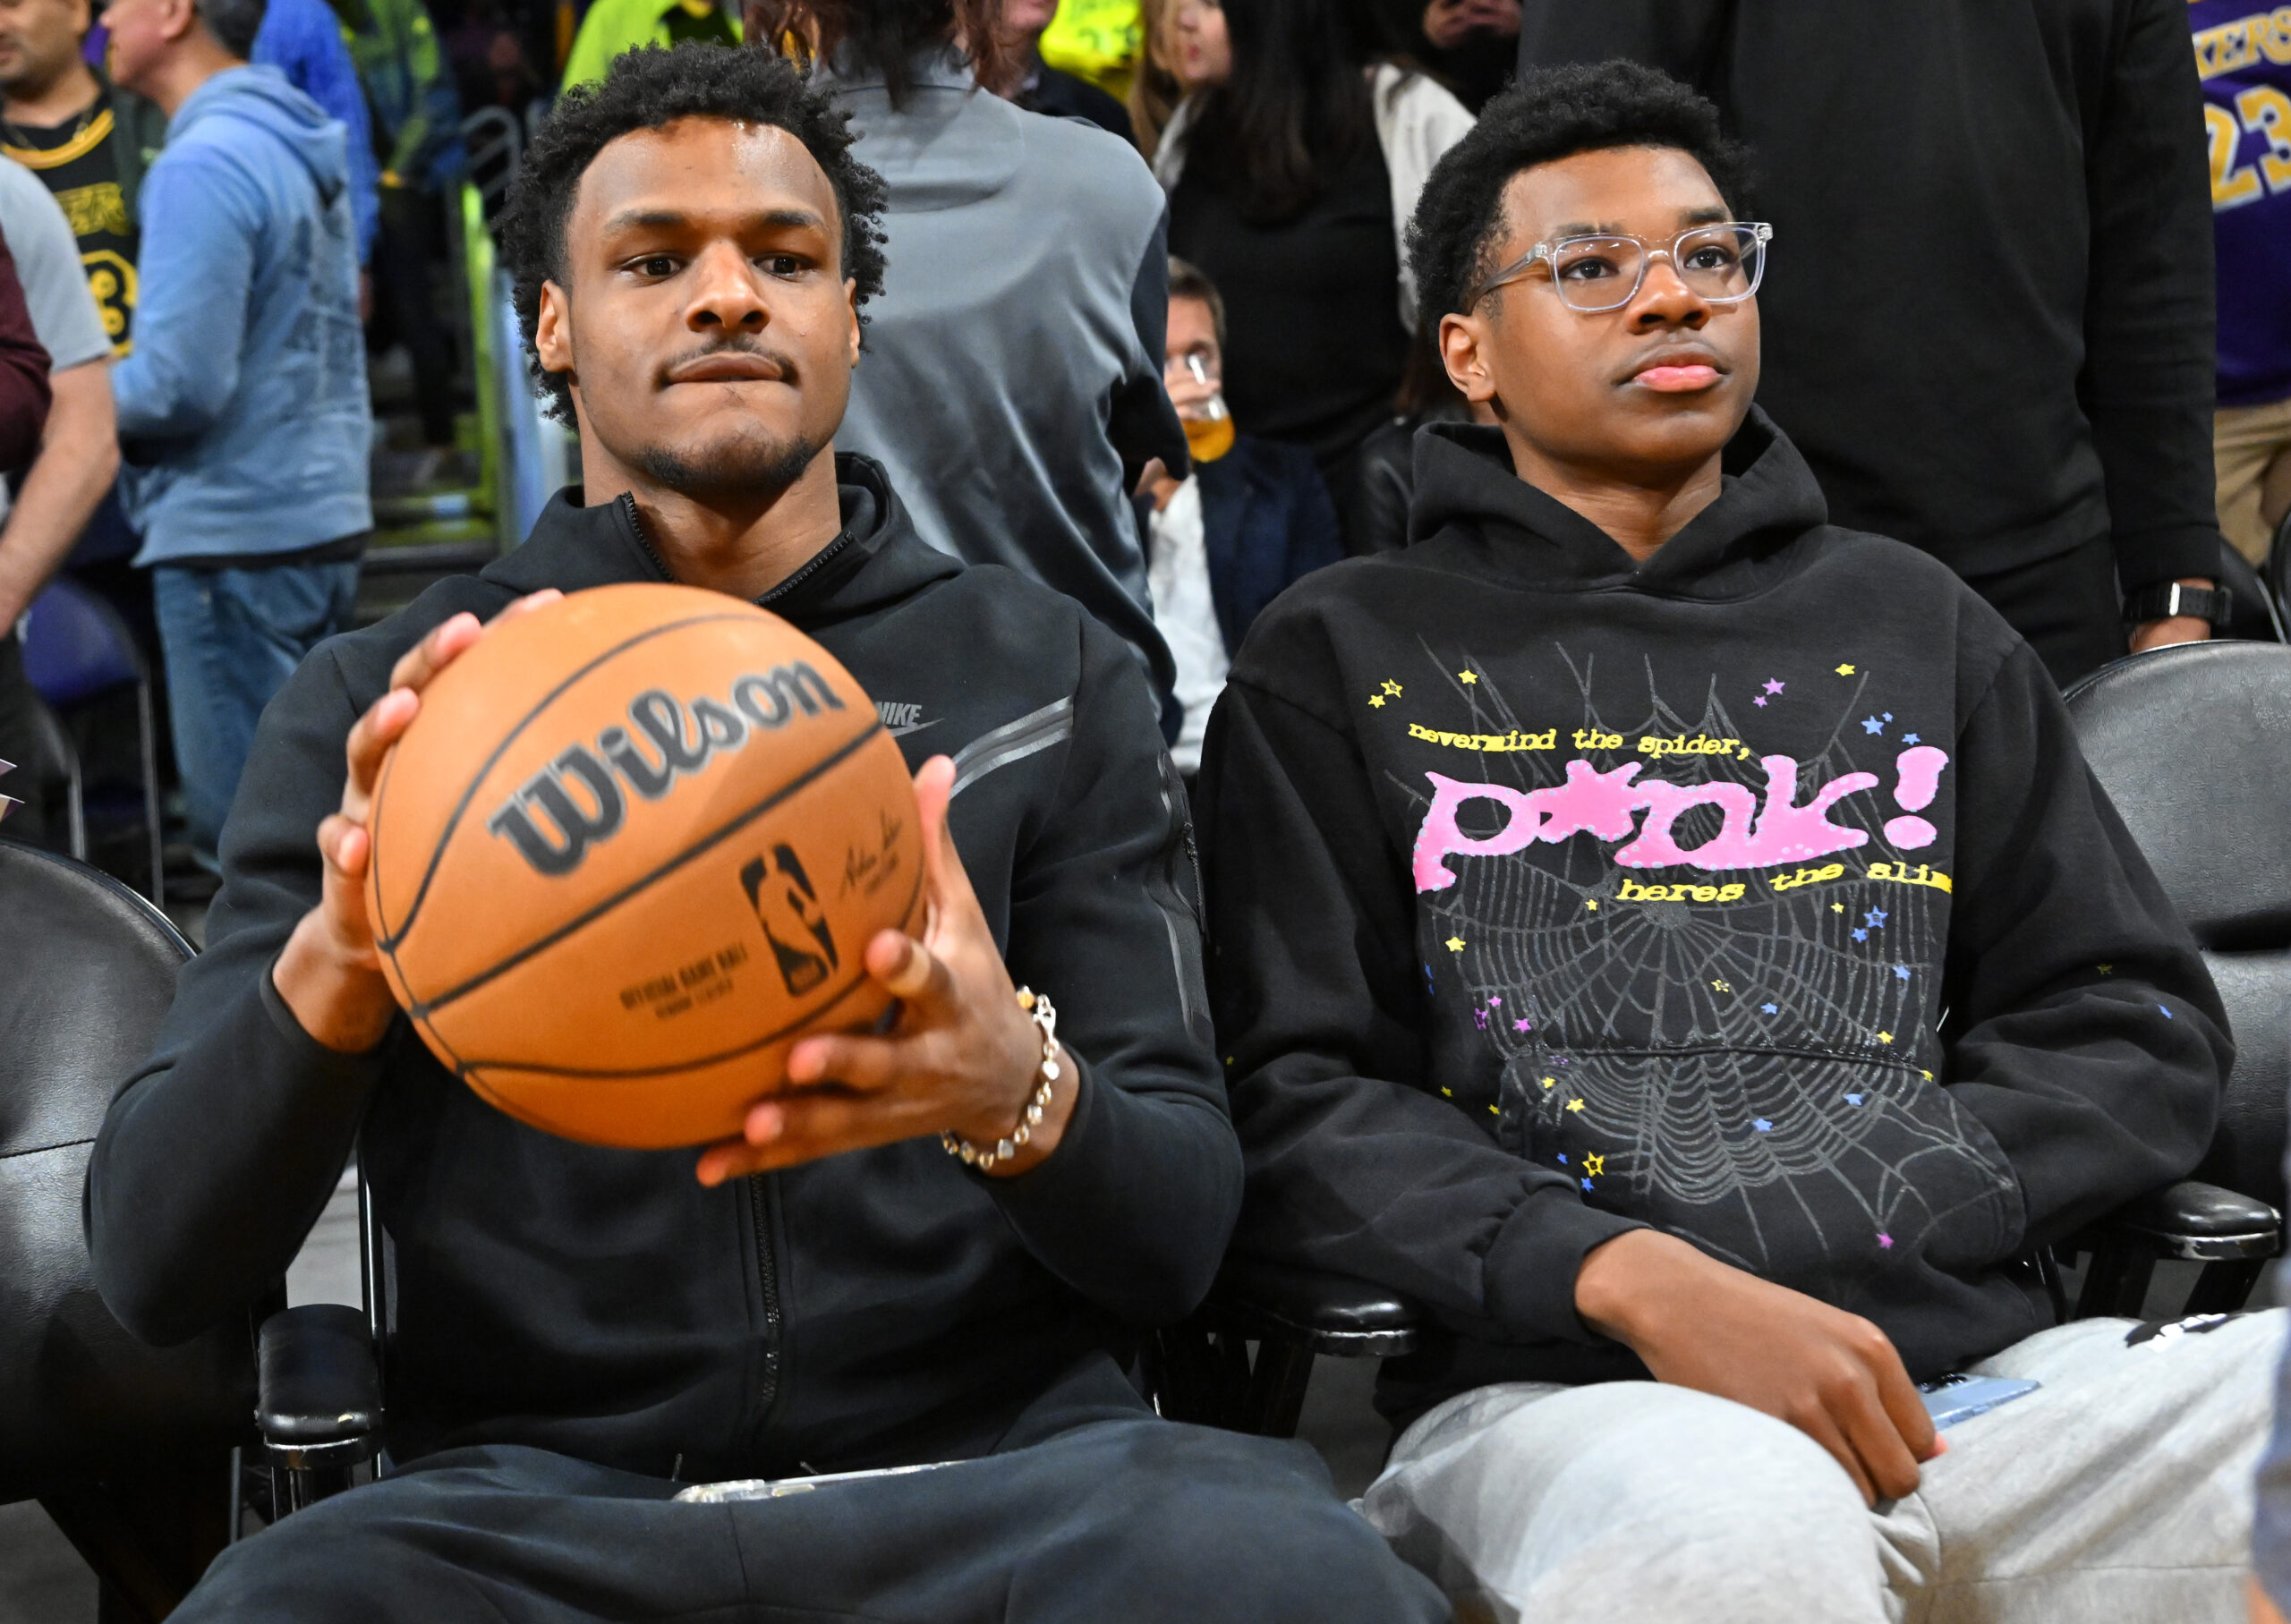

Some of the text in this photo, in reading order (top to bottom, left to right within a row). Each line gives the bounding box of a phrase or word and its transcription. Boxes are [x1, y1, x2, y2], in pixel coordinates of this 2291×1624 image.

[876, 701, 923, 727] NIKE
[1409, 723, 1751, 761] nevermind the spider,
[487, 659, 846, 876] Wilson
[1615, 878, 1747, 903] heres
[1768, 863, 1841, 892] the
